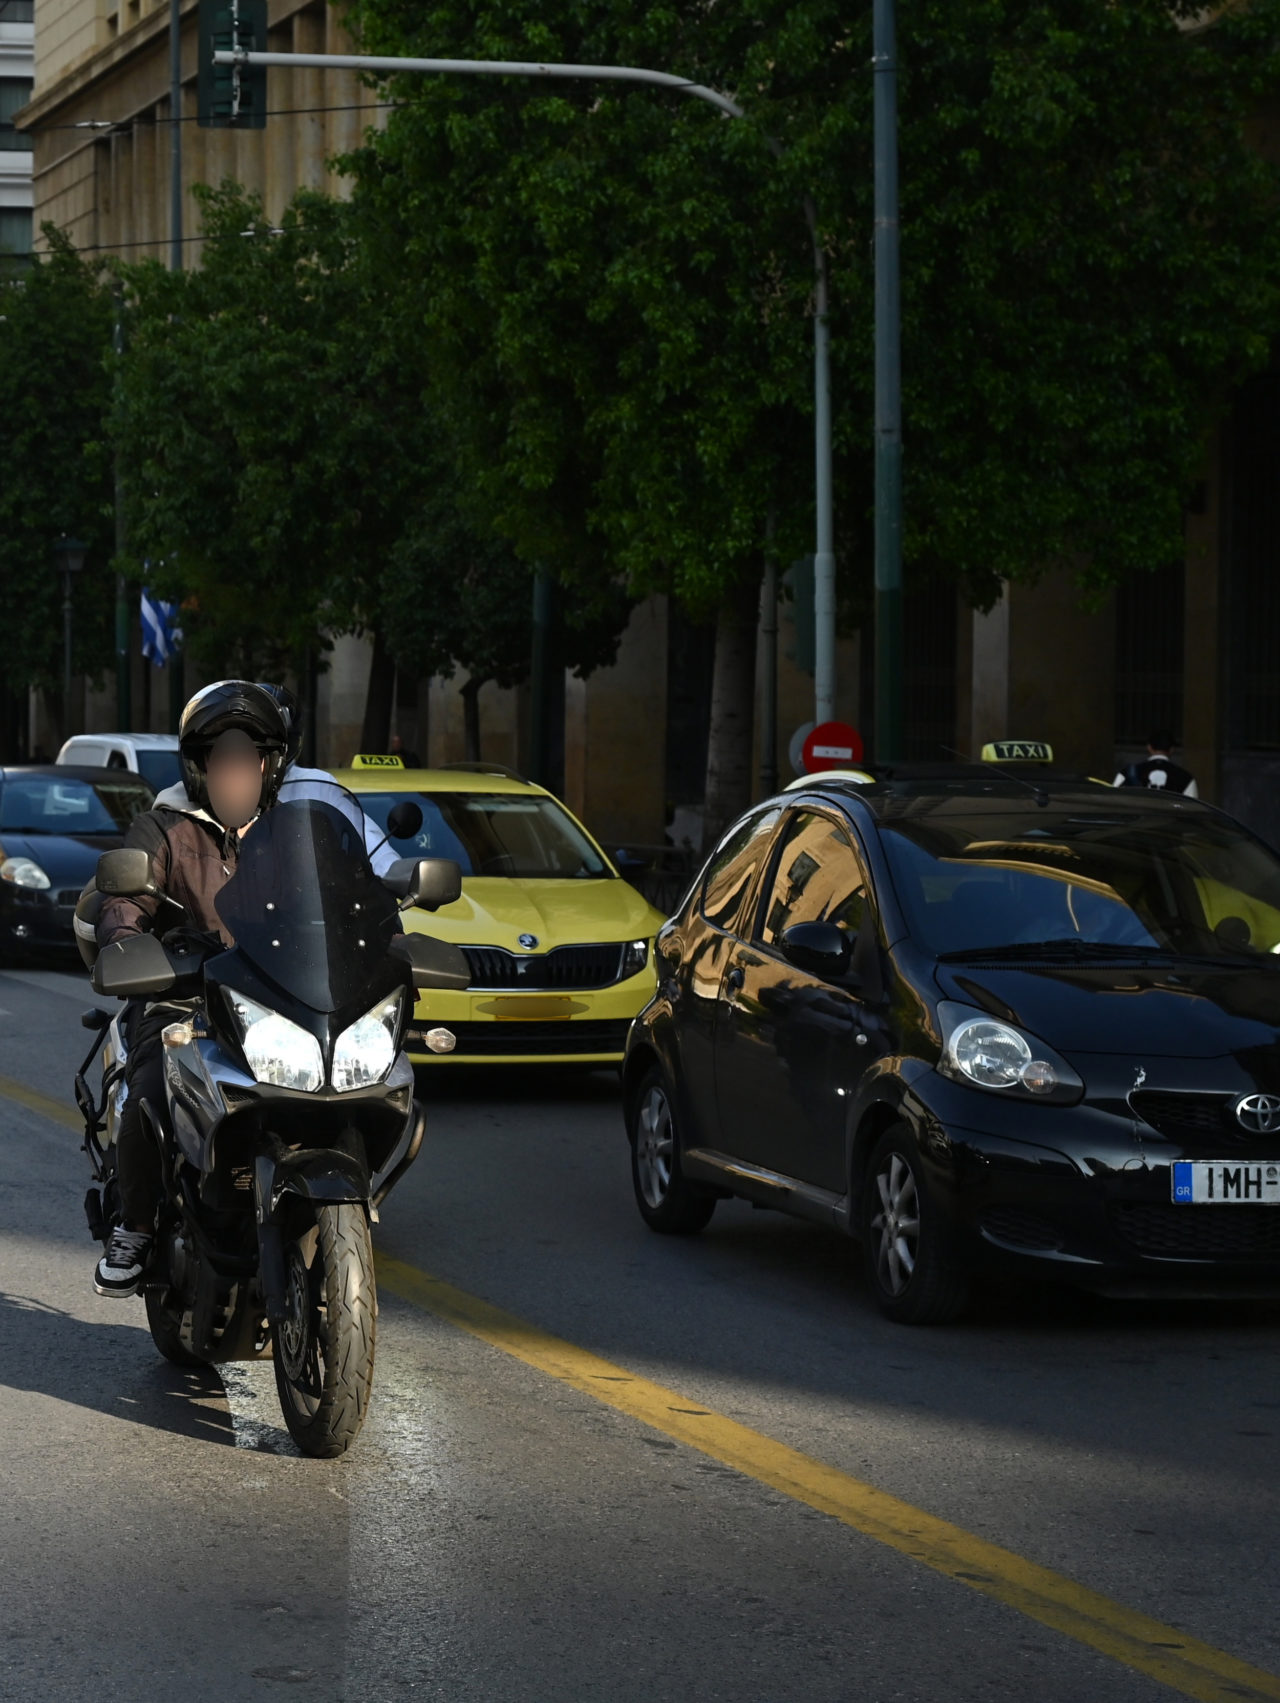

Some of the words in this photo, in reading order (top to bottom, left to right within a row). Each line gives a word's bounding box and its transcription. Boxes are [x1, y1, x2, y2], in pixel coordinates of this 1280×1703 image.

[1000, 745, 1044, 757] TAXI
[363, 756, 397, 765] TAXI
[1176, 1187, 1191, 1196] GR
